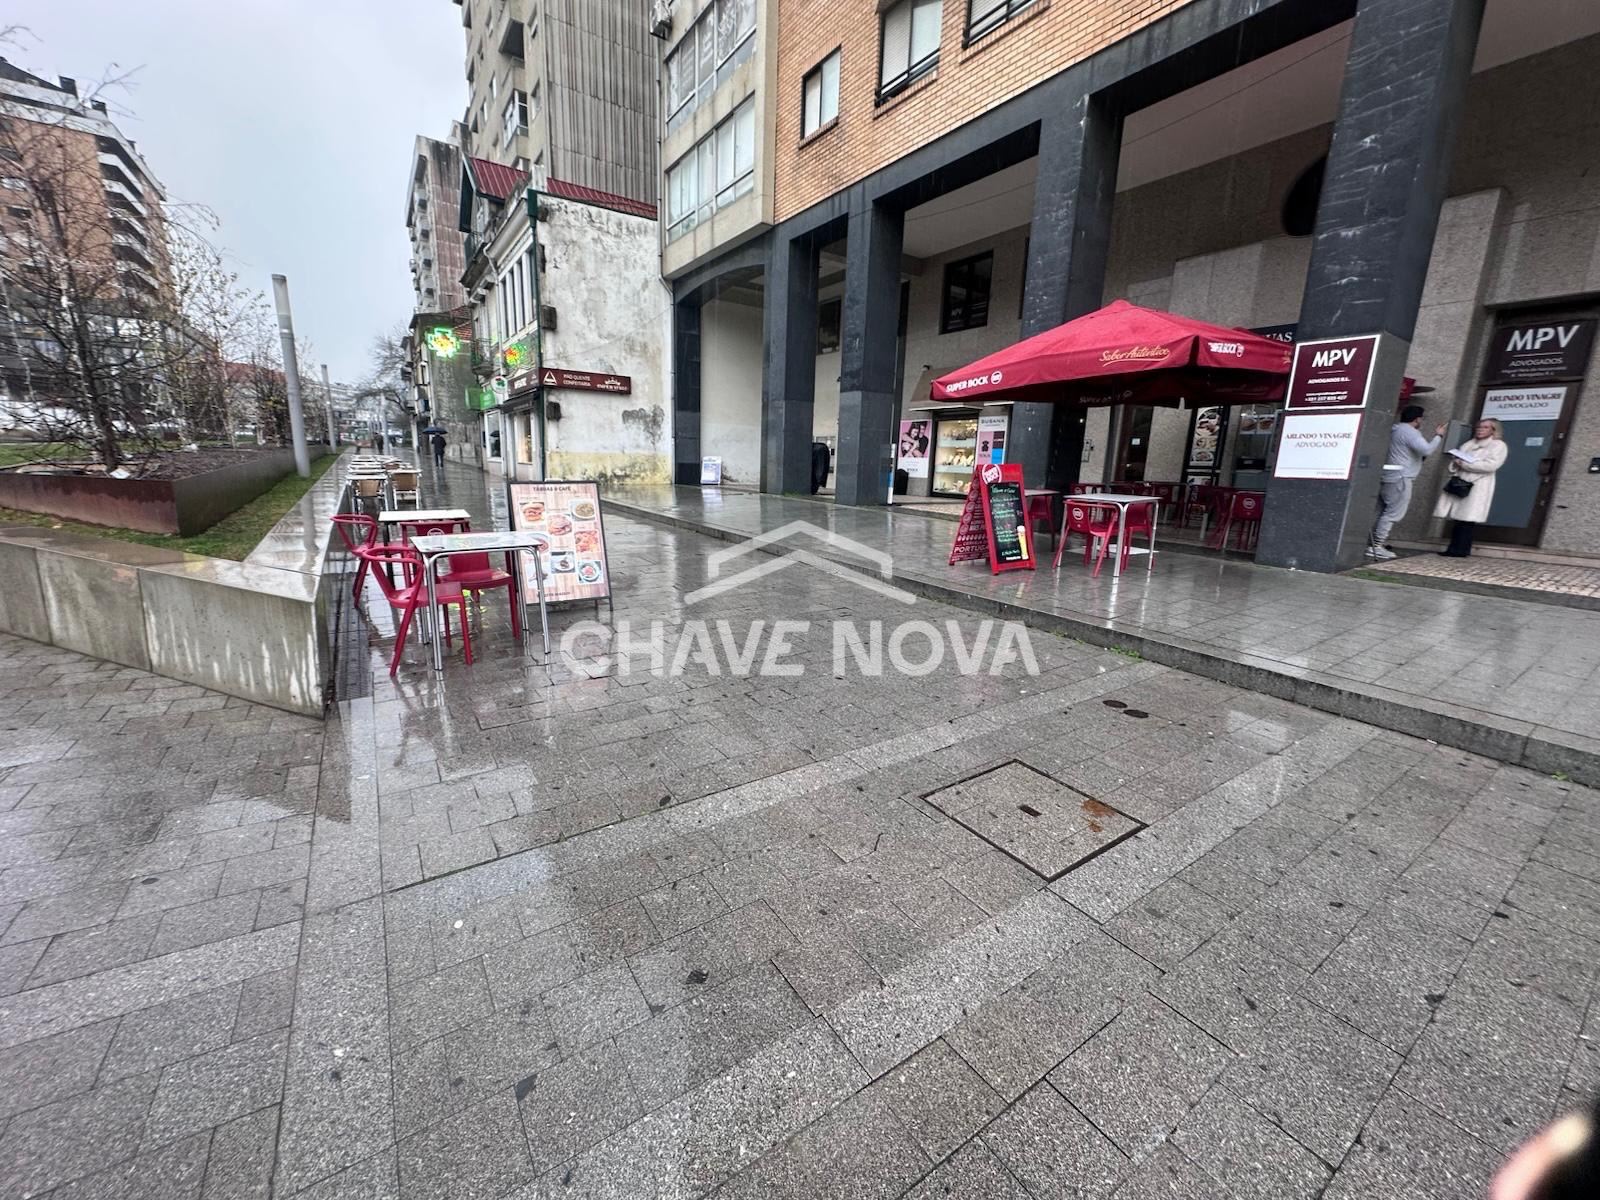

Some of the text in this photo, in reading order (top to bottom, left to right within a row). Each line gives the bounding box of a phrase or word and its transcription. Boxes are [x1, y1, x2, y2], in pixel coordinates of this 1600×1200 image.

[1505, 324, 1580, 352] MPV
[1099, 349, 1126, 362] Sabor
[1311, 347, 1357, 368] MPV
[1508, 357, 1563, 367] ADVOGADOS
[945, 381, 968, 393] SUPER
[967, 375, 989, 388] BOCK
[1489, 392, 1561, 402] ARLINDO VINAGRE
